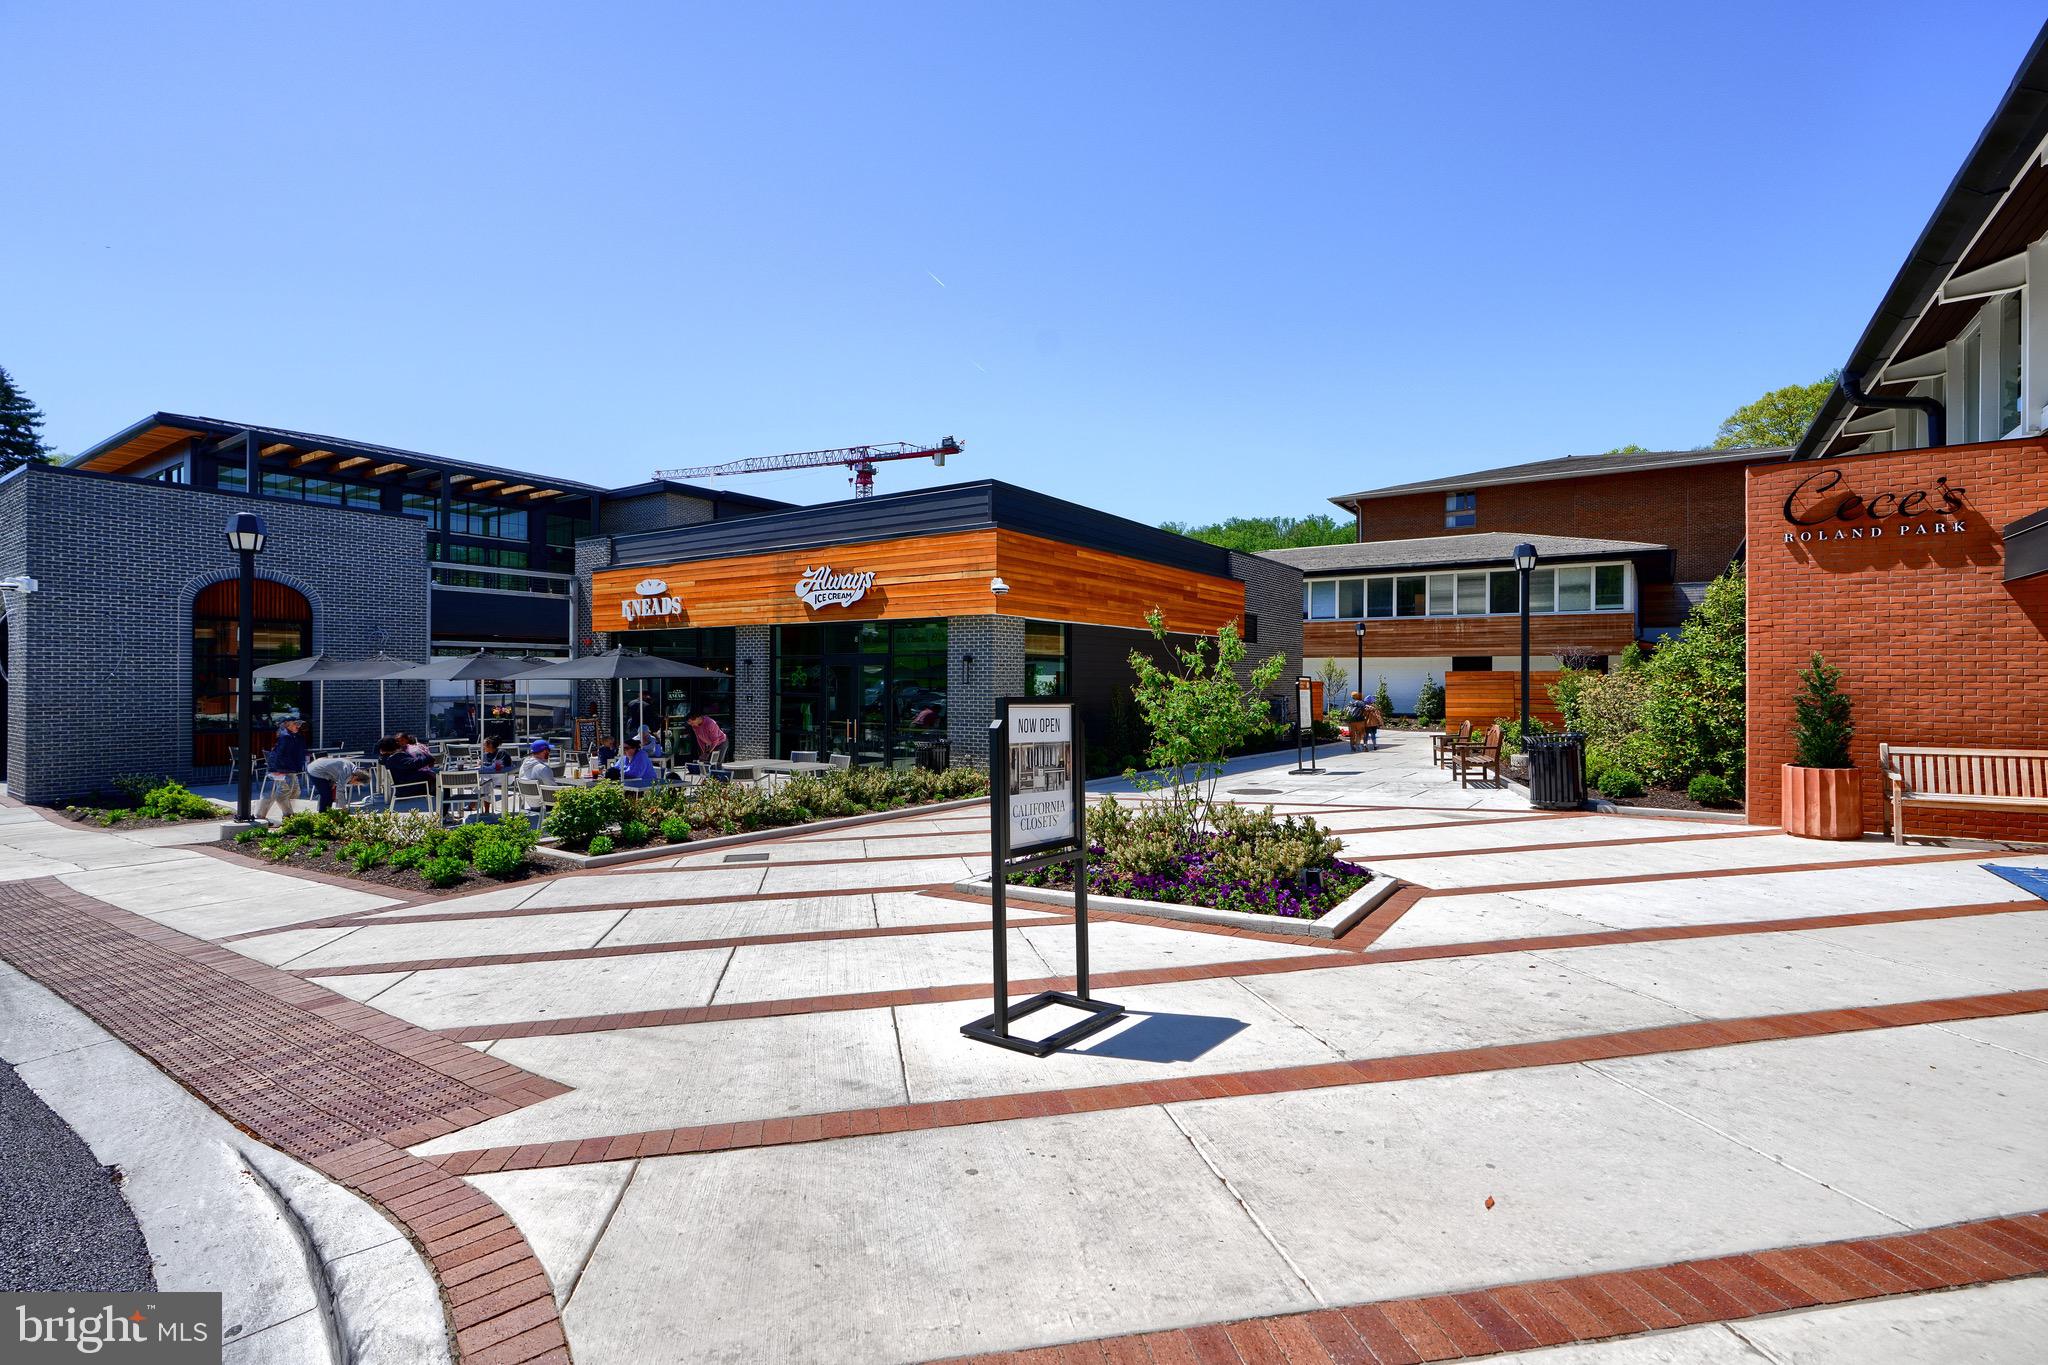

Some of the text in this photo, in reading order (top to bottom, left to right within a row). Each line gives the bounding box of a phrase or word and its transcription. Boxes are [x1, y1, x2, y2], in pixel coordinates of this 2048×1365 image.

[1783, 469, 1966, 526] Cece's
[1784, 521, 1966, 543] ROLAND PARK
[795, 565, 876, 598] Always
[621, 596, 682, 621] KNEADS
[814, 592, 853, 605] ICE CREAM
[1018, 718, 1060, 733] NOW OPEN
[1012, 800, 1065, 818] CALIFORNIA
[1020, 815, 1058, 831] CLOSETS
